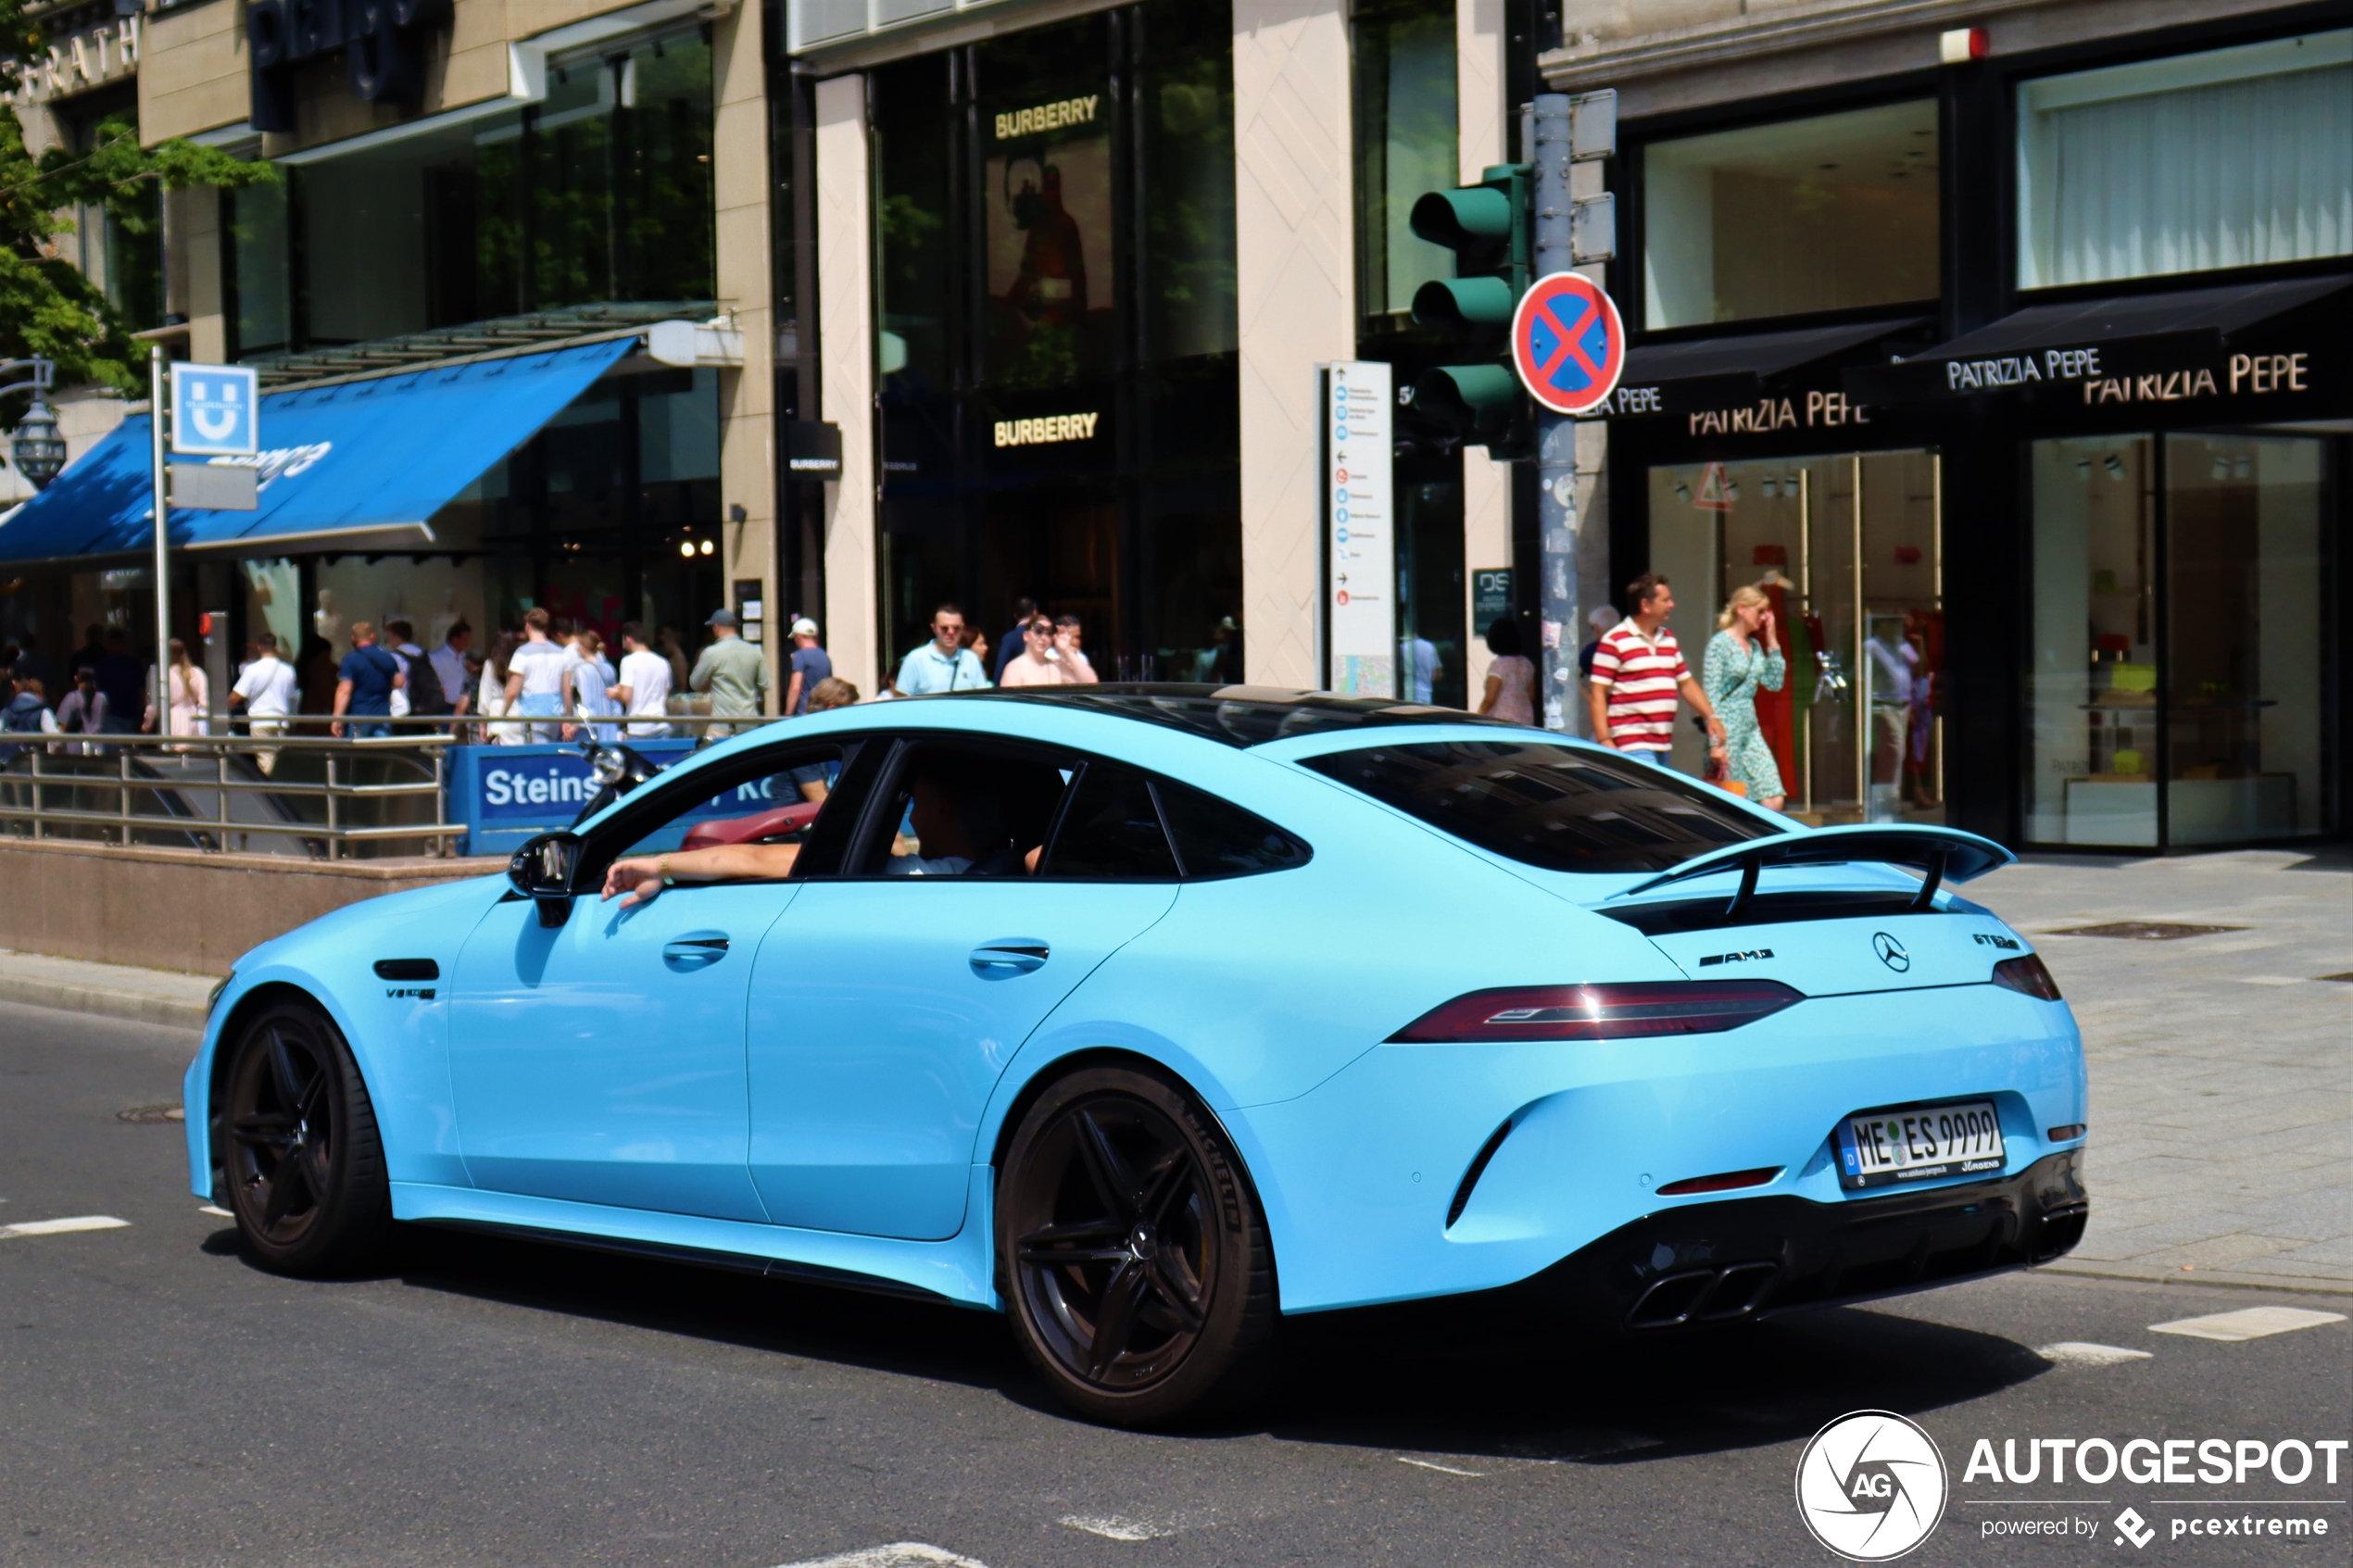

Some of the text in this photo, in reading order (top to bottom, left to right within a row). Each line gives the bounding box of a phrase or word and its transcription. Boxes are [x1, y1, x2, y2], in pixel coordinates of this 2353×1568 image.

[995, 94, 1099, 140] BURBERRY
[1946, 347, 2102, 390] PATRIZIA PEPE
[2230, 352, 2309, 395] PEPE
[1617, 386, 1663, 414] PEPE
[994, 411, 1099, 447] BURBERRY
[790, 458, 838, 470] BURBERRY
[1724, 948, 1775, 964] AMG
[1847, 1110, 1994, 1167] D ME ES 9999
